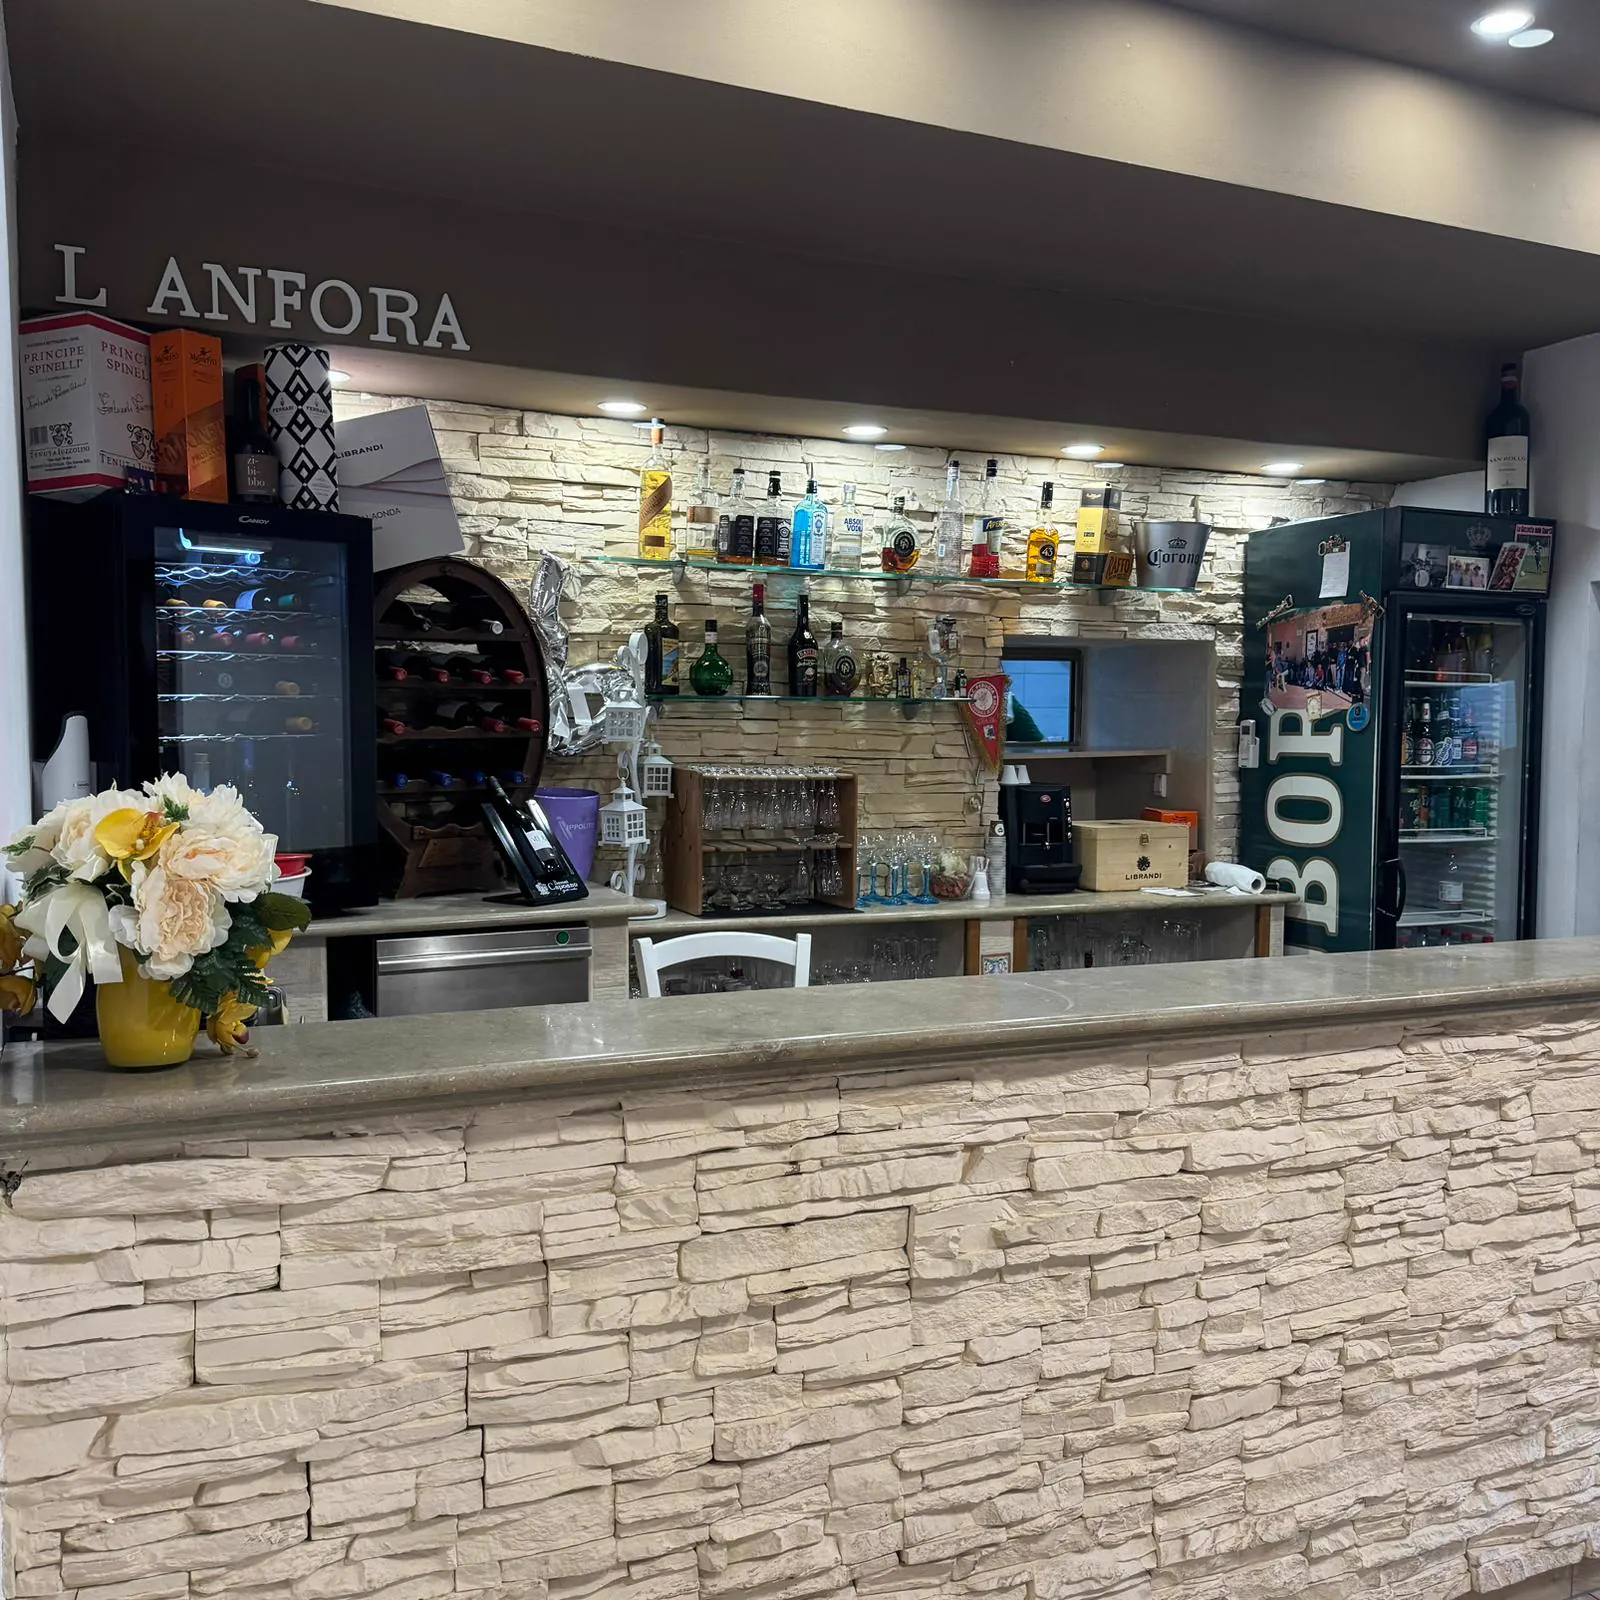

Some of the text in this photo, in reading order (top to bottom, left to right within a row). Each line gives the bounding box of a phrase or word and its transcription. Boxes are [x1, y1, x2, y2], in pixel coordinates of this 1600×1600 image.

[54, 244, 471, 352] L ANFORA
[23, 345, 85, 363] PRINCIPE
[101, 341, 148, 366] PRINCI
[336, 443, 384, 460] LIBRANDI
[238, 515, 270, 525] CANDY
[1041, 546, 1054, 558] 43
[1124, 872, 1162, 881] LIBRANDI
